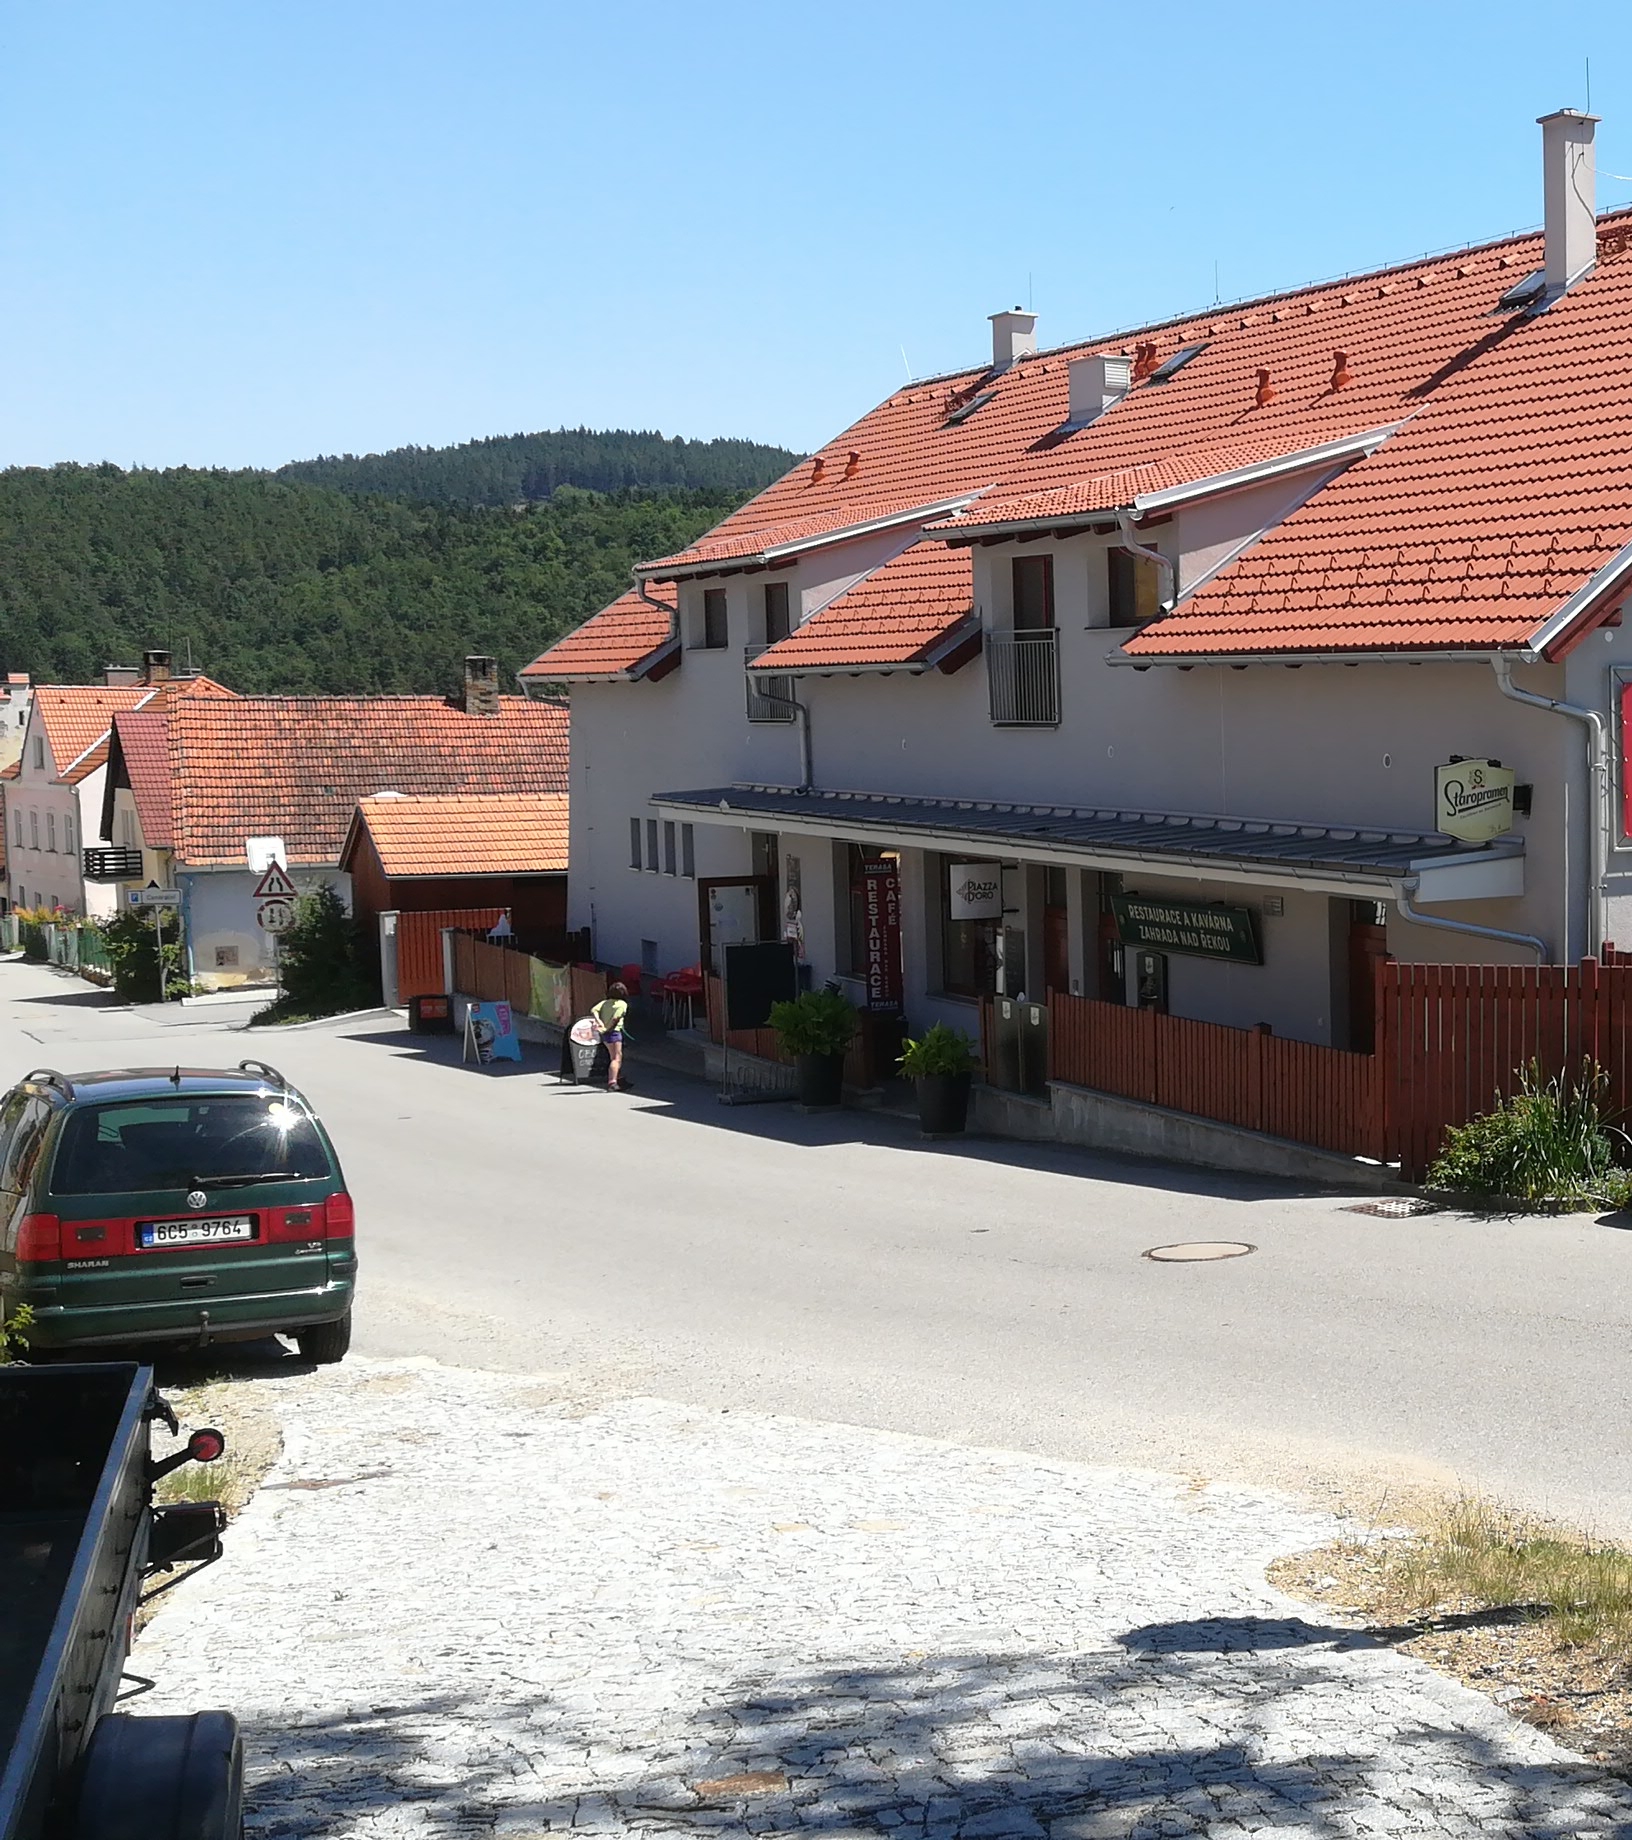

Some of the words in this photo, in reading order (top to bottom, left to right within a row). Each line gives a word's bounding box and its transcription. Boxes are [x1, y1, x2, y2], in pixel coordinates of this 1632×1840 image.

[1444, 780, 1510, 816] Staropramen
[967, 880, 998, 891] PIAZZA
[885, 877, 897, 926] CAFÉ
[1128, 904, 1182, 926] RESTAURACE
[1183, 911, 1191, 926] A
[1190, 910, 1234, 932] KAVÁRNA
[866, 879, 882, 998] RESTAURACE
[1139, 925, 1178, 944] ZAHRADA
[1180, 931, 1199, 946] NAD
[1200, 930, 1231, 951] ŘEKOU
[157, 1223, 188, 1241] 6C5
[201, 1220, 242, 1237] 9764
[66, 1260, 110, 1269] SHARAN
